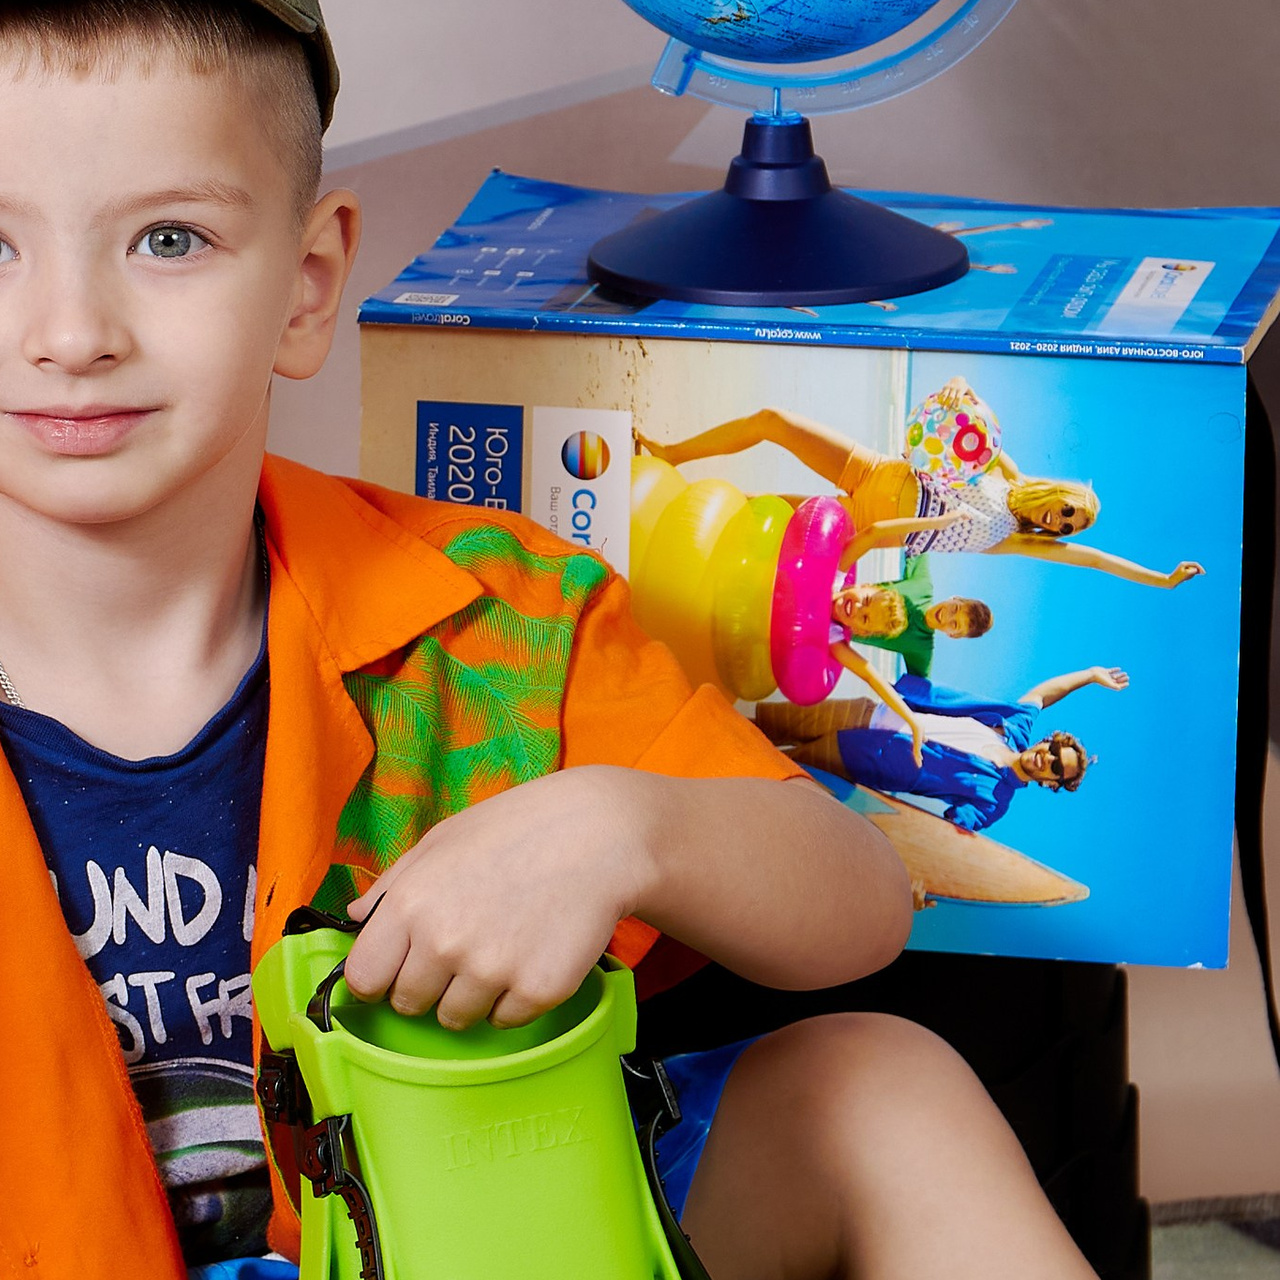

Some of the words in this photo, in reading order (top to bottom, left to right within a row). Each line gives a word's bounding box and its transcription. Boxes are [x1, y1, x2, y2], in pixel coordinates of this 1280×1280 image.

[1060, 343, 1093, 354] ИНДИЯ
[1122, 346, 1204, 359] ЮГО-ВОСТОЧНАЯ
[427, 421, 440, 464] Индия,
[550, 486, 561, 511] Ваш
[443, 1106, 593, 1171] INTEX
